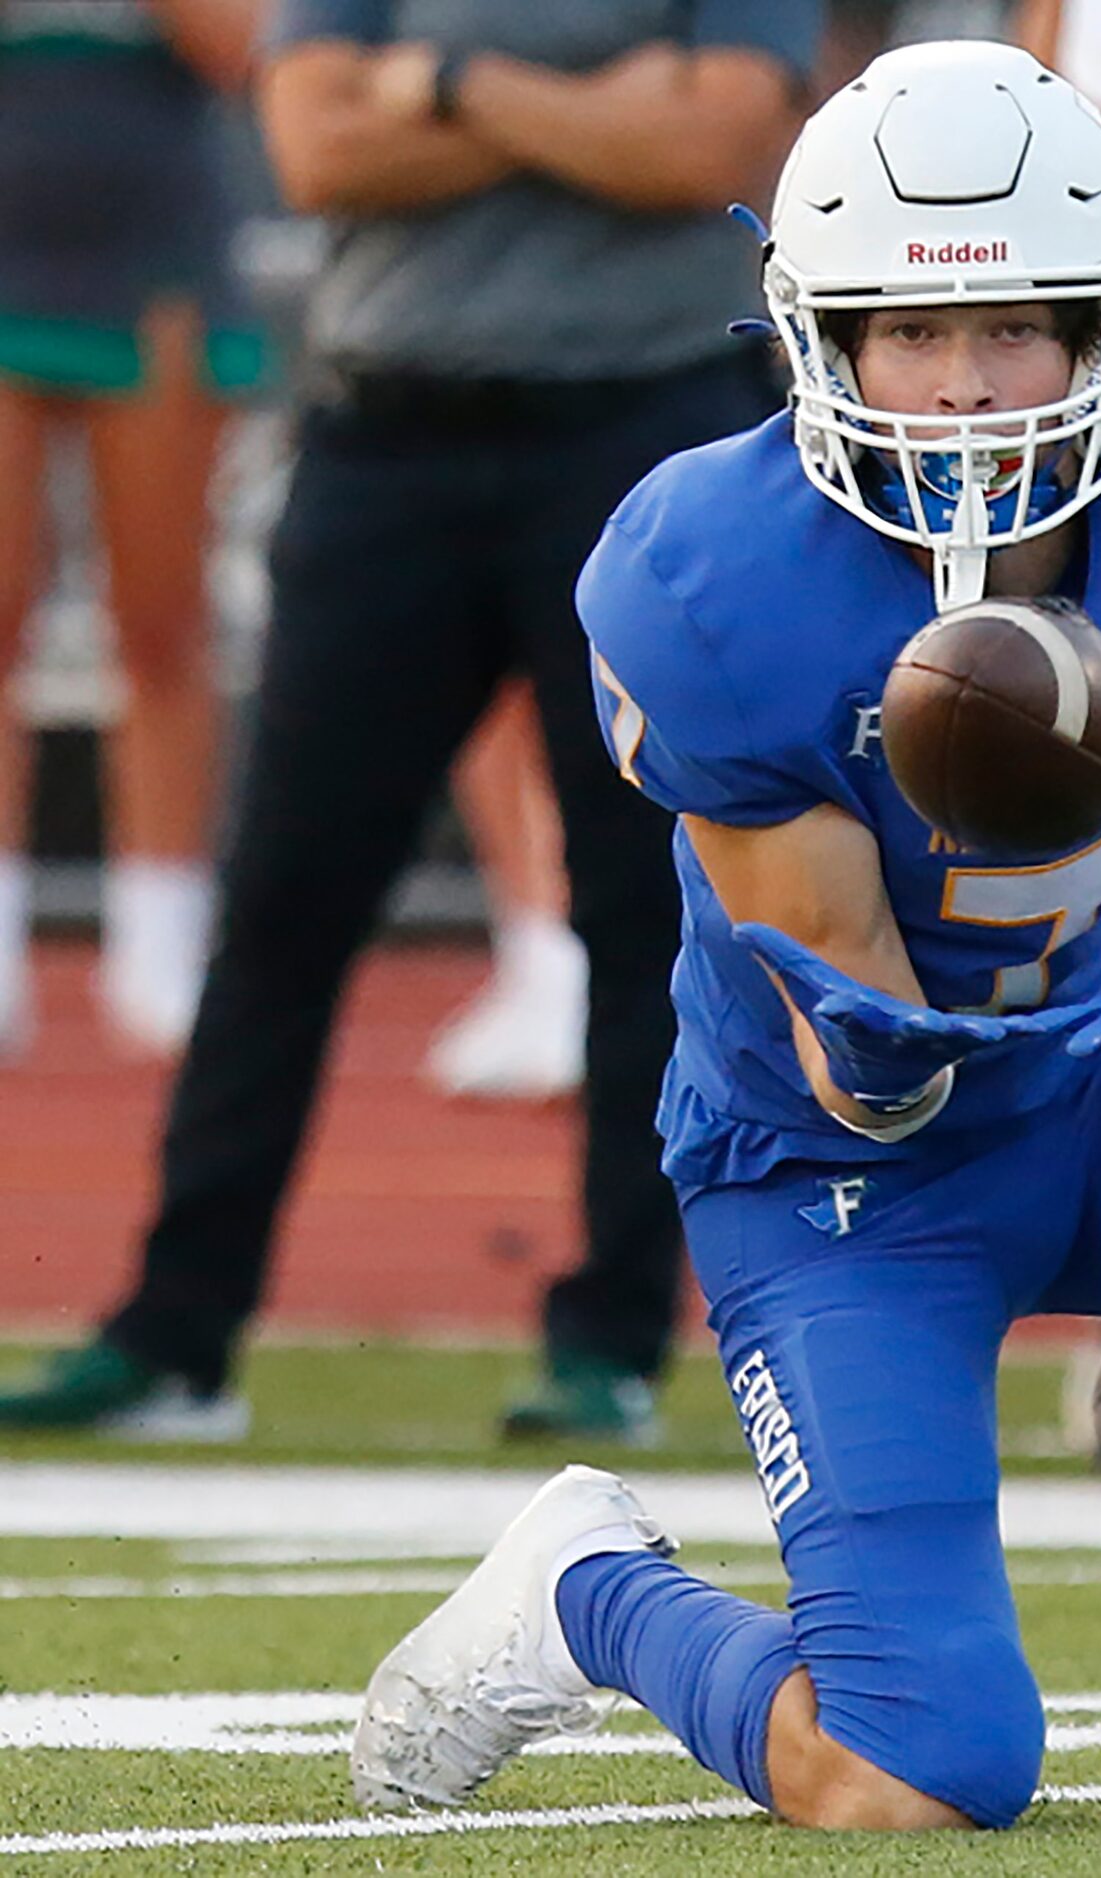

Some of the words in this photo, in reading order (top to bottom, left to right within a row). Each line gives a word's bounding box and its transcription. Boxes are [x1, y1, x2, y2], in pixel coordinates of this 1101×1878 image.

[907, 241, 1007, 264] Riddell
[829, 1177, 866, 1236] F
[733, 1349, 813, 1523] FRISCO
